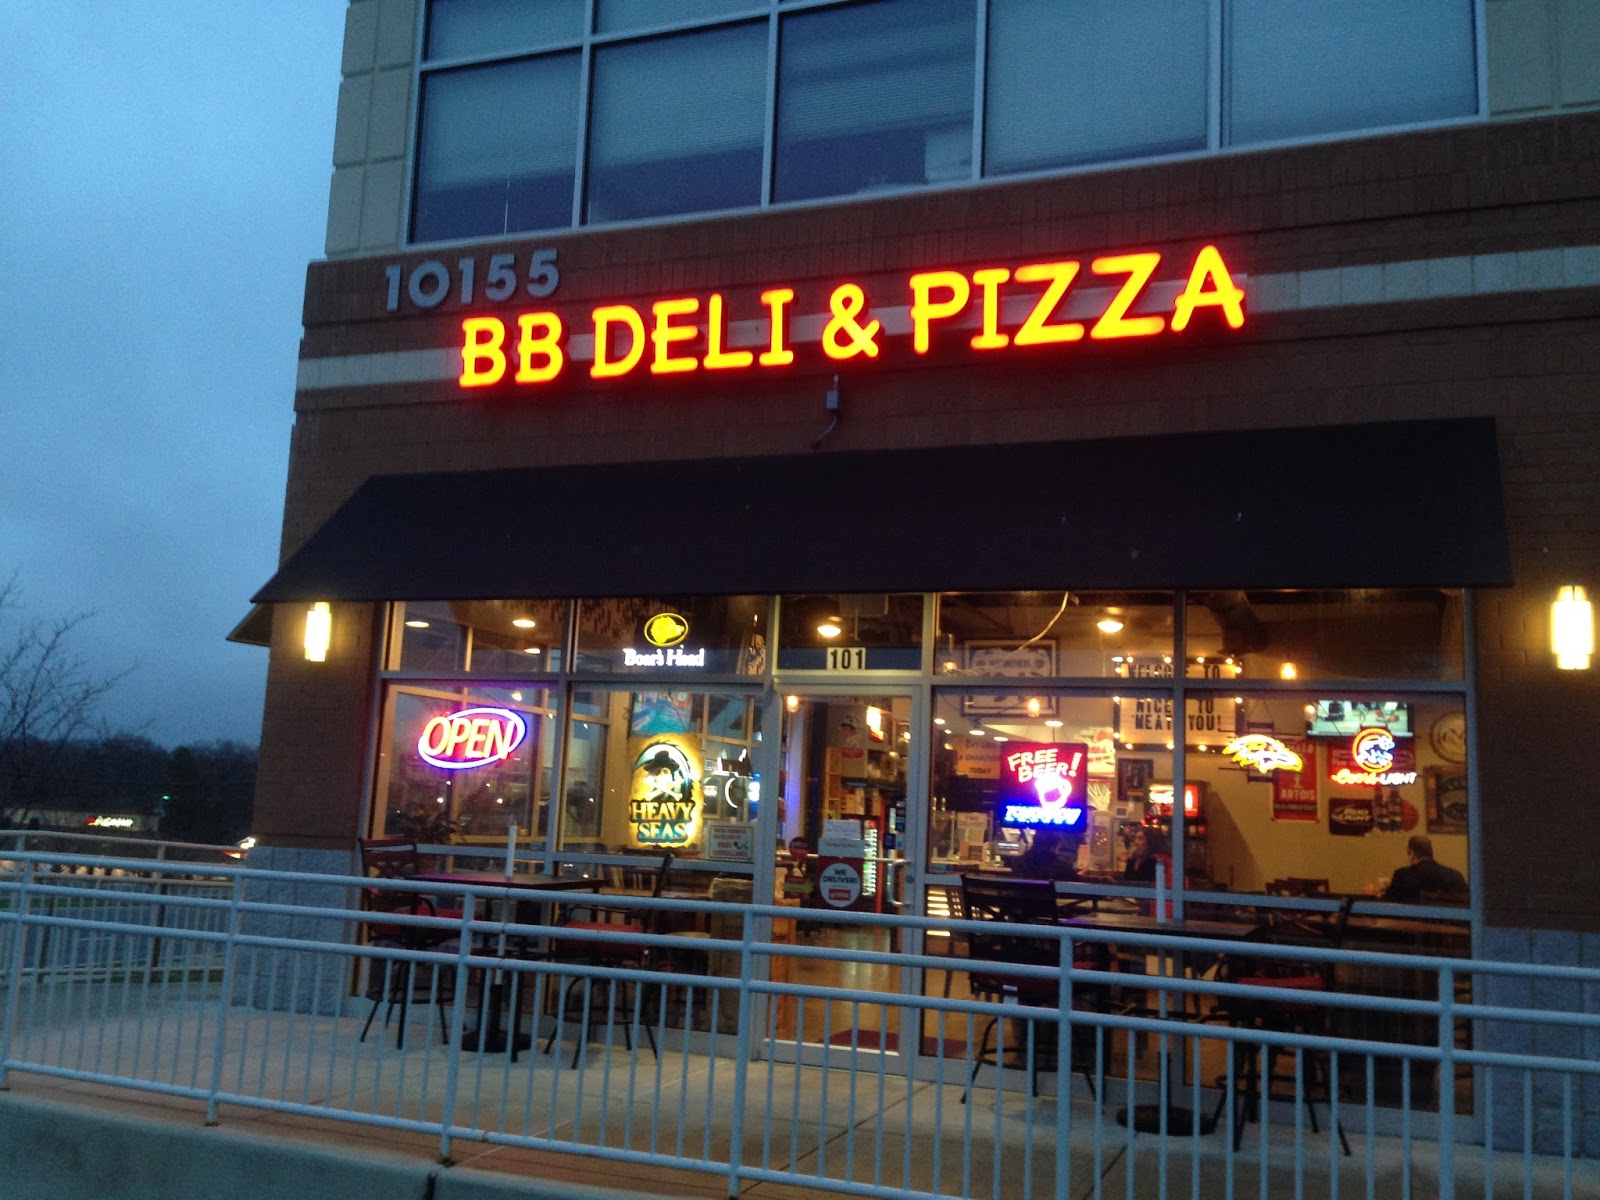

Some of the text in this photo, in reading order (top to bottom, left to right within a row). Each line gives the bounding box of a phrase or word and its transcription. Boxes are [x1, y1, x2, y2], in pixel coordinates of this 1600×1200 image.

[384, 248, 560, 312] 10155
[458, 244, 1246, 388] BB DELI & PIZZA
[830, 648, 865, 669] 101
[1204, 664, 1221, 679] TO
[1136, 698, 1172, 714] NICE
[421, 715, 516, 760] OPEN
[1007, 748, 1059, 772] FREE
[1280, 788, 1316, 801] ARTOIS
[631, 801, 695, 821] HEAVY
[637, 822, 688, 841] SEAS
